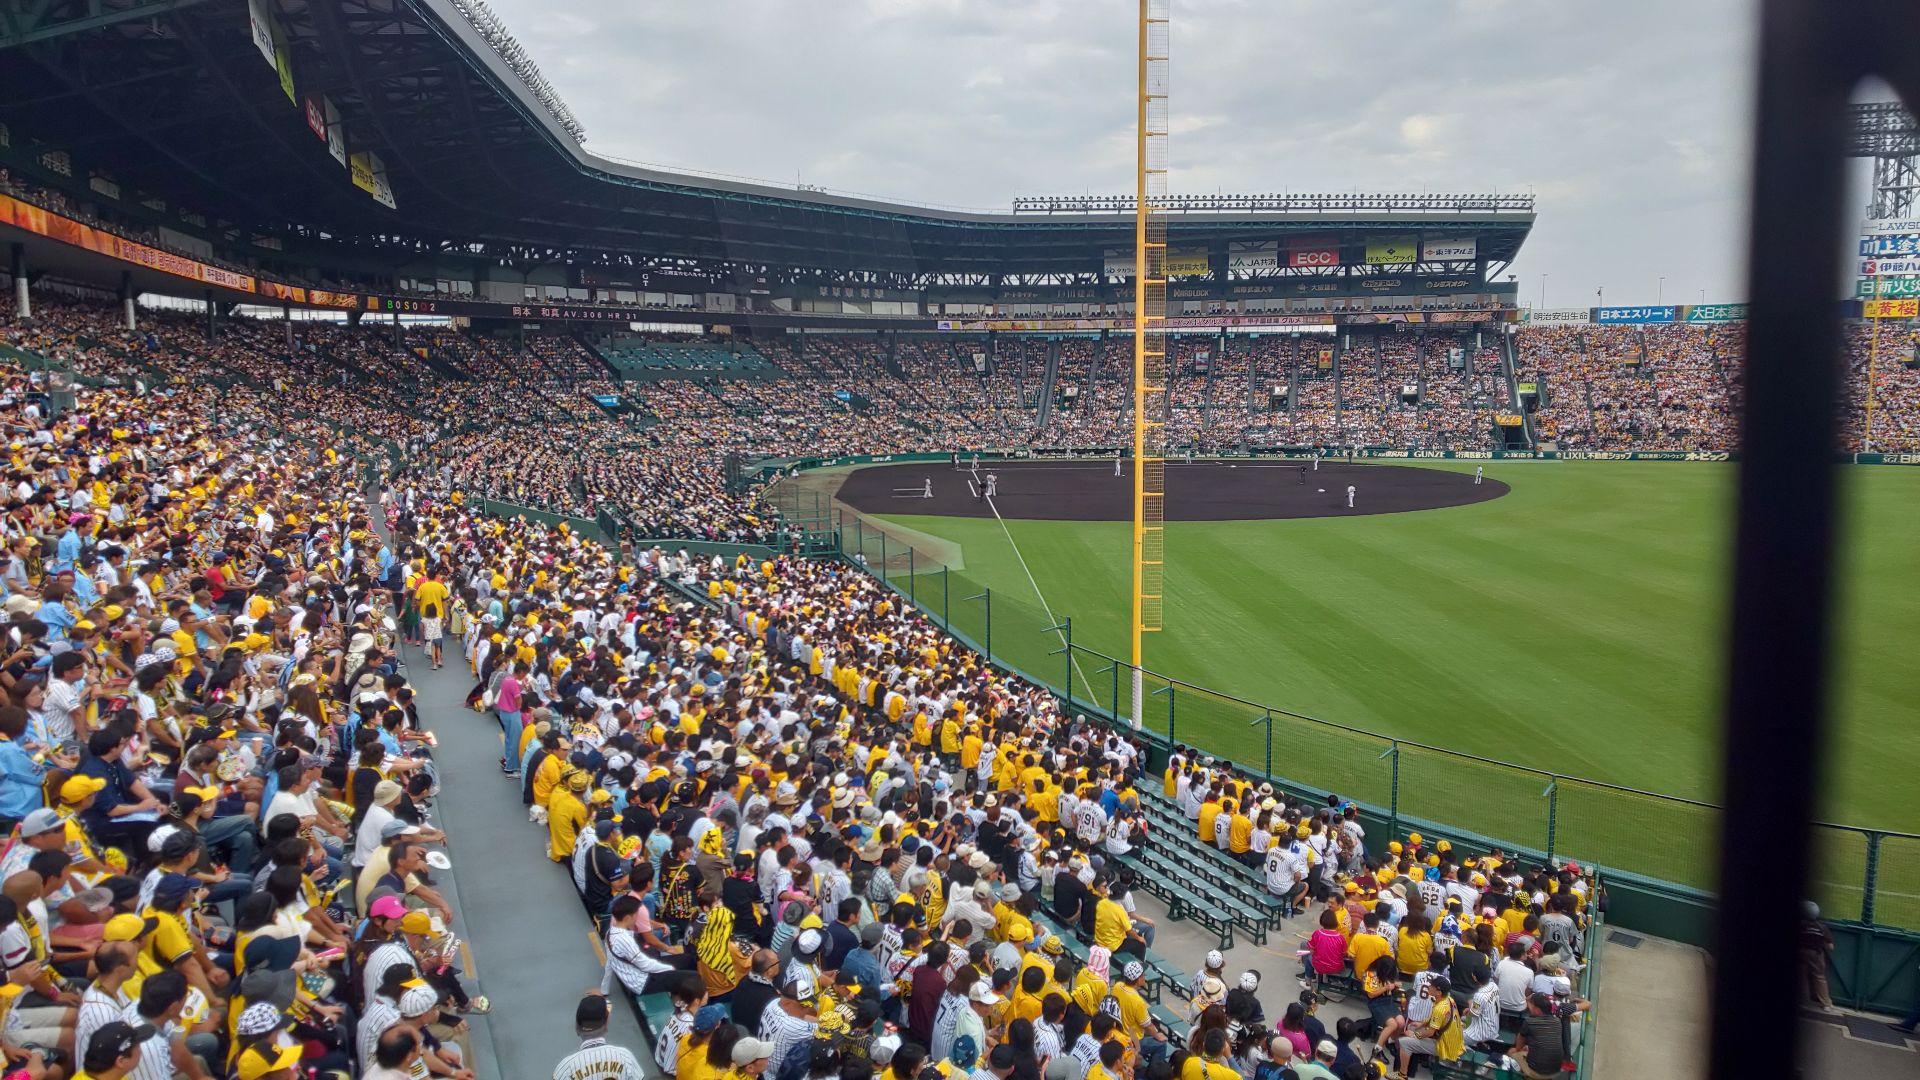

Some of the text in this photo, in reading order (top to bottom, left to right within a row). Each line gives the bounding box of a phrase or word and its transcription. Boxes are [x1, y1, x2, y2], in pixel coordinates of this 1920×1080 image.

[1247, 258, 1277, 267] JA共済
[1297, 252, 1331, 264] ECC
[1880, 262, 1920, 272] 伊藤ハ
[513, 306, 532, 317] 岡本
[608, 312, 621, 320] HR
[1600, 308, 1674, 320] 日本エスリード
[1879, 301, 1917, 316] 黄桜
[1533, 312, 1589, 321] 明治安田生命
[1413, 450, 1446, 458] GUNZE
[1216, 823, 1222, 834] 9
[1270, 859, 1277, 872] 8
[1421, 893, 1439, 906] 62
[569, 1061, 624, 1080] FUJIKAWA
